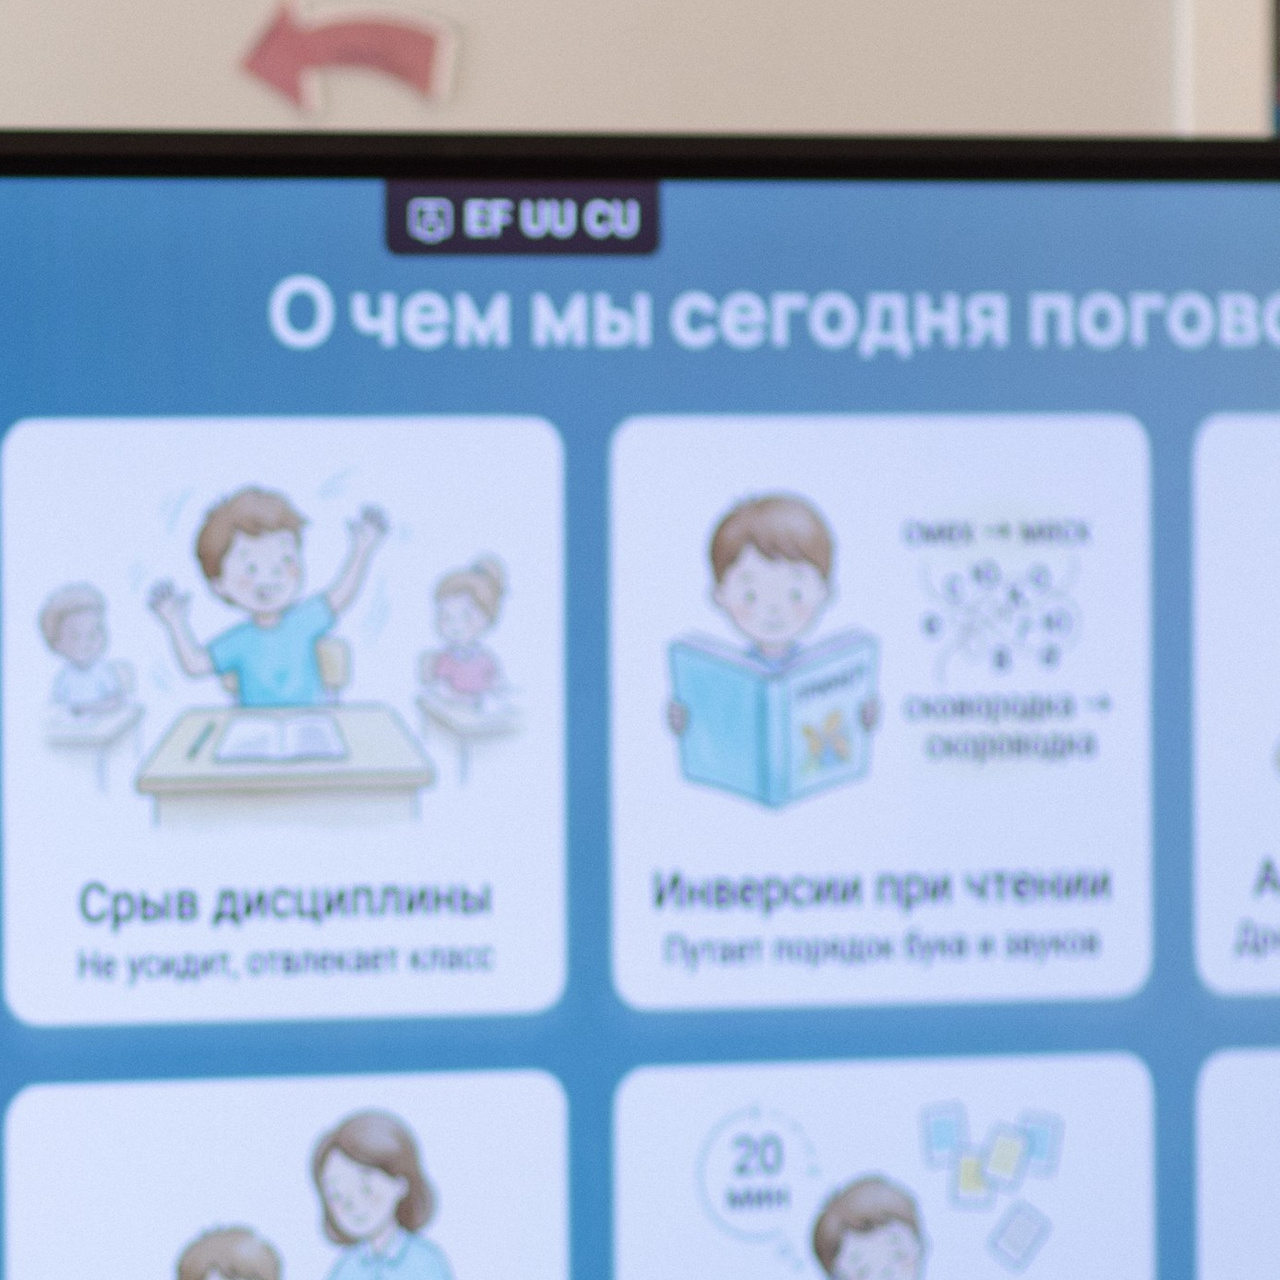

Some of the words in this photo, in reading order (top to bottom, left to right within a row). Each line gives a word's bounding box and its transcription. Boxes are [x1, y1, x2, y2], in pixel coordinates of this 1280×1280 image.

[269, 275, 335, 349] О
[351, 291, 511, 349] чем
[532, 292, 652, 348] мы
[670, 291, 1009, 358] сегодня
[78, 881, 200, 932] Срыв
[211, 885, 492, 927] дисциплины
[653, 872, 863, 916] Инверсии
[875, 873, 953, 913] при
[965, 871, 1112, 903] чтении
[77, 952, 118, 980] Не
[127, 951, 238, 985] усидит,
[246, 948, 398, 976] отвлекает
[408, 946, 492, 972] класс
[664, 933, 764, 971] Путает
[772, 936, 896, 967] порядок
[733, 1133, 784, 1179] 20
